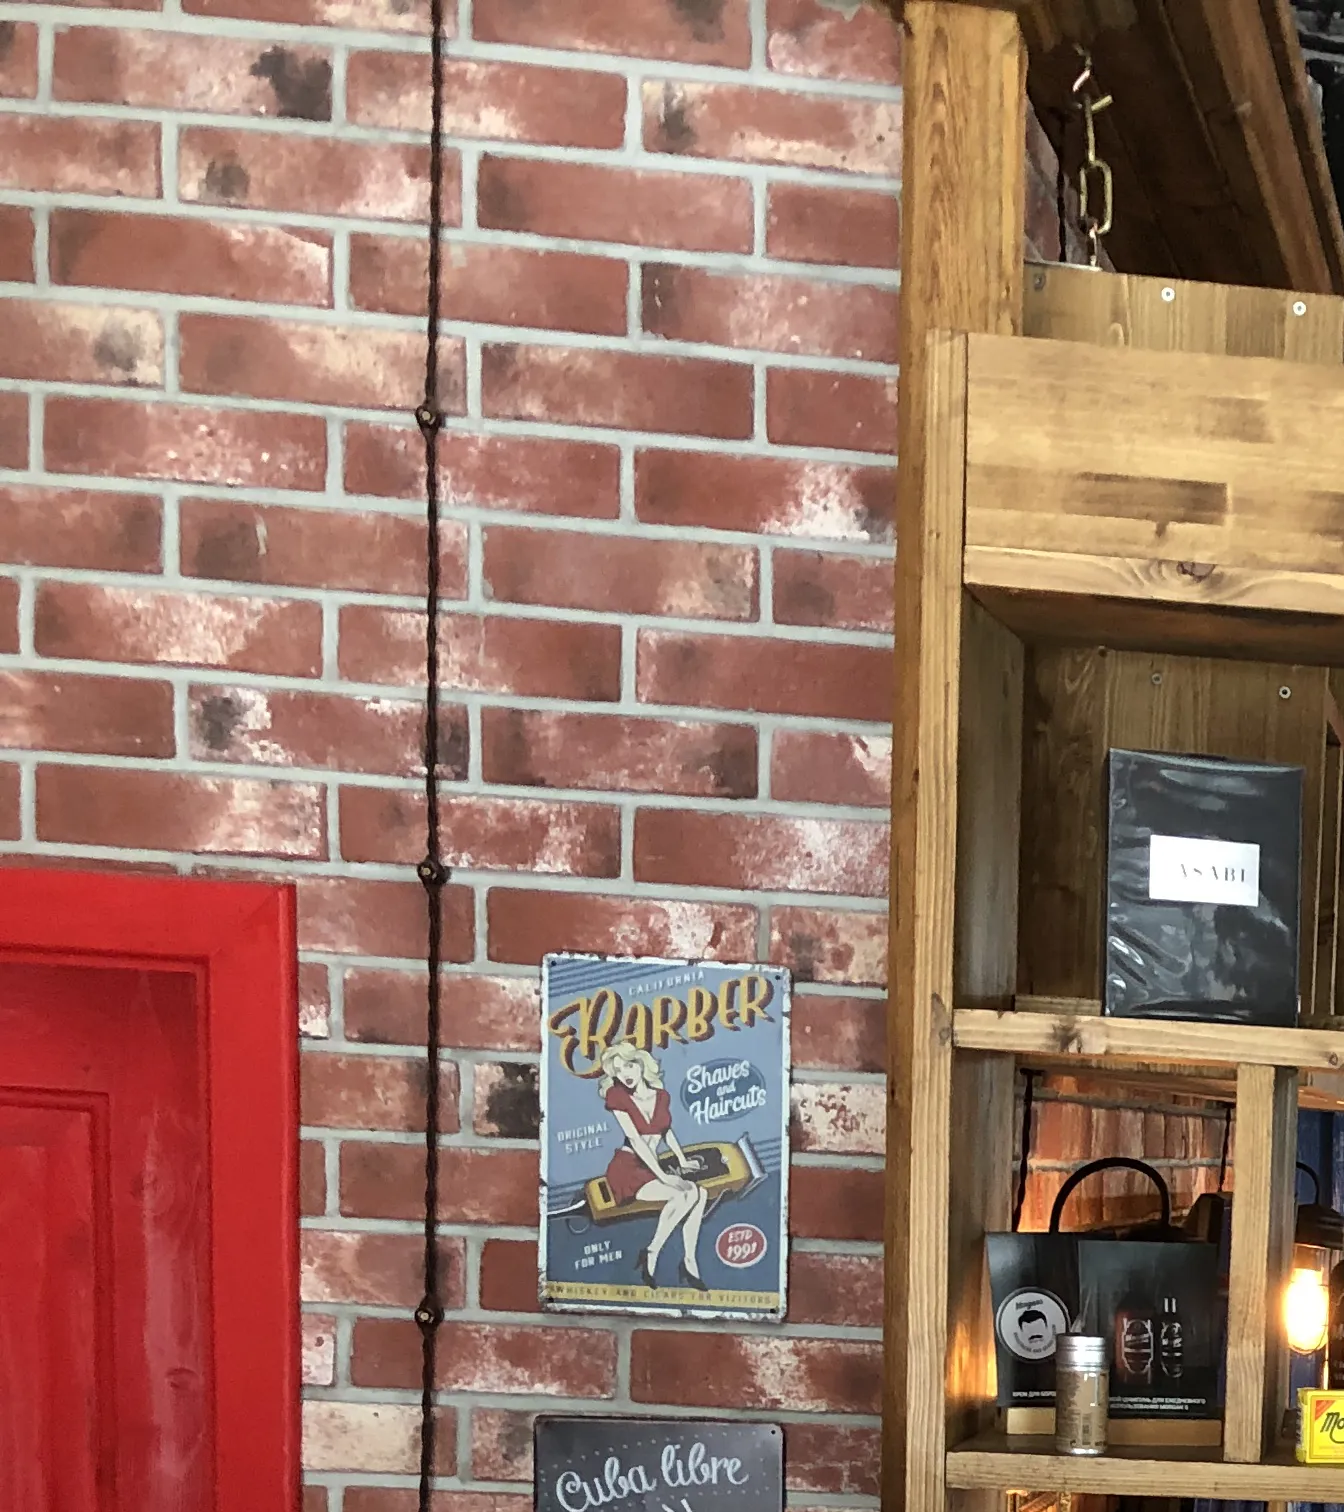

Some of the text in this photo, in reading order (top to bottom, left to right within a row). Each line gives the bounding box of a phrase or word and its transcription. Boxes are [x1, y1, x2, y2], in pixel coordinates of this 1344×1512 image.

[628, 970, 706, 997] CALIFORNIA
[549, 973, 776, 1079] BARBER
[686, 1058, 750, 1095] Shaves
[715, 1081, 737, 1096] and
[689, 1085, 766, 1126] Haircuts
[556, 1122, 610, 1142] ORIGINAL
[564, 1138, 604, 1155] STYLE
[583, 1240, 612, 1256] ONLY
[574, 1250, 623, 1270] FOR MEN
[660, 1441, 749, 1488] libre
